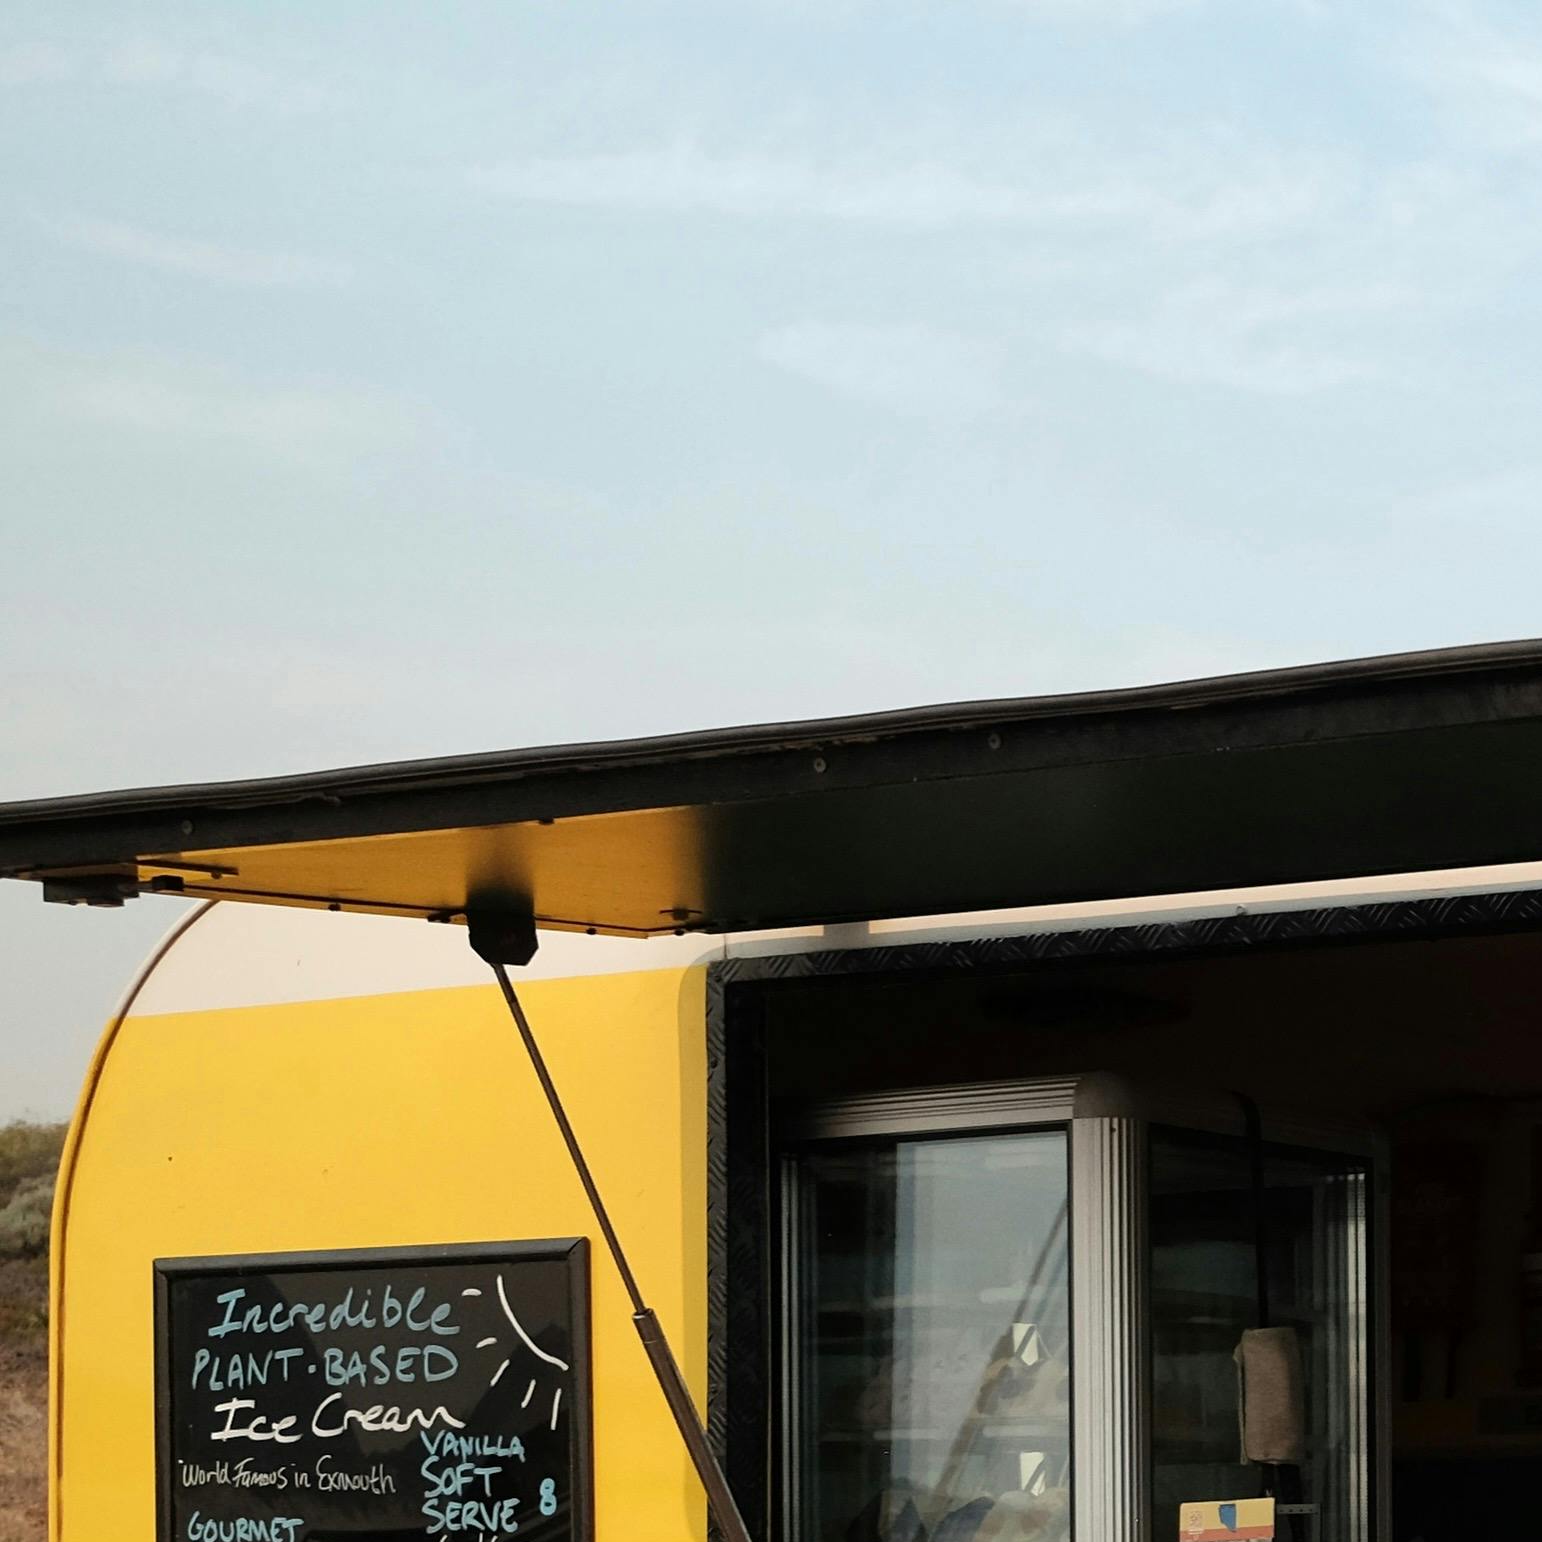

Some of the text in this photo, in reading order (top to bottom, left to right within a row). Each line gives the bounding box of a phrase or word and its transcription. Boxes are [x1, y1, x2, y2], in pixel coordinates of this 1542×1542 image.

[208, 1285, 460, 1337] Incredible
[211, 1392, 466, 1442] Ice Cream
[420, 1430, 526, 1463] VANILLA
[179, 1454, 397, 1495] World Famous in Exmouth
[421, 1455, 502, 1498] SOFT
[421, 1477, 557, 1534] SERVE 8
